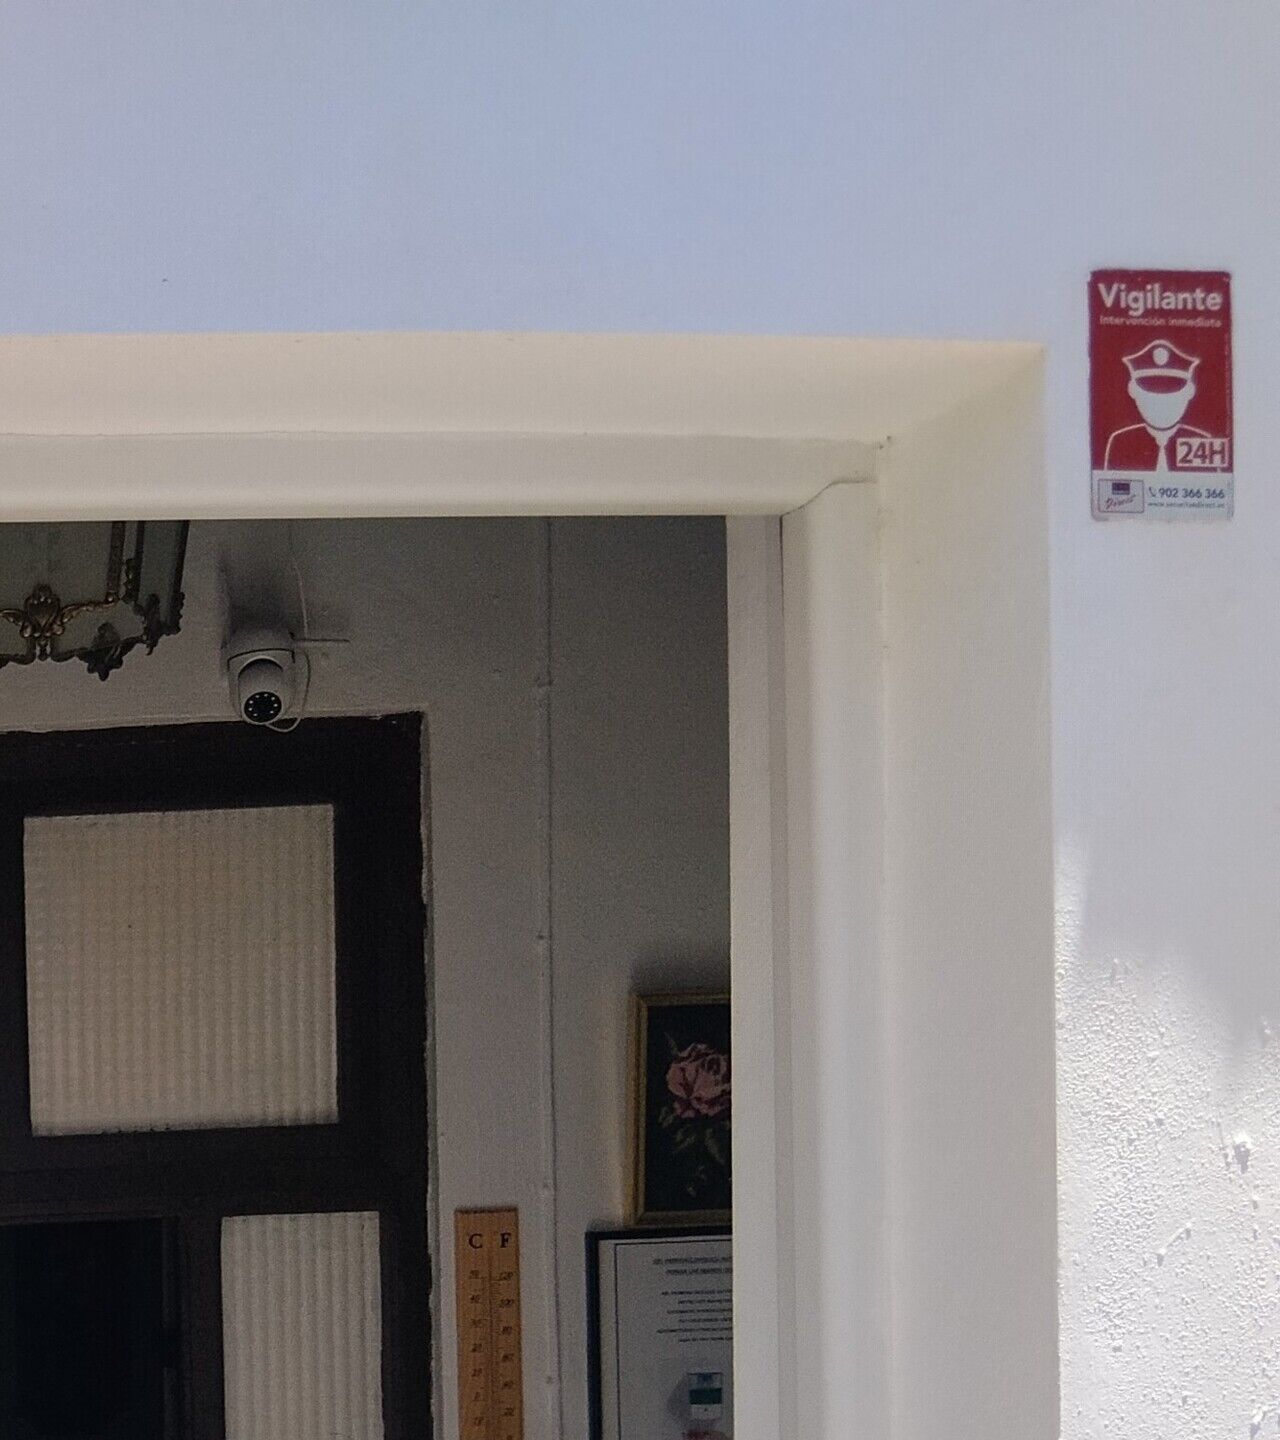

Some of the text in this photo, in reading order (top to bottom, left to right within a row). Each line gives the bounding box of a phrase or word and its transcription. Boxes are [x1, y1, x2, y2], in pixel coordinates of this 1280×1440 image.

[1098, 283, 1223, 317] Vigilante
[1177, 440, 1228, 466] 24H
[1158, 488, 1226, 499] 902 366 366
[468, 1232, 512, 1249] C F
